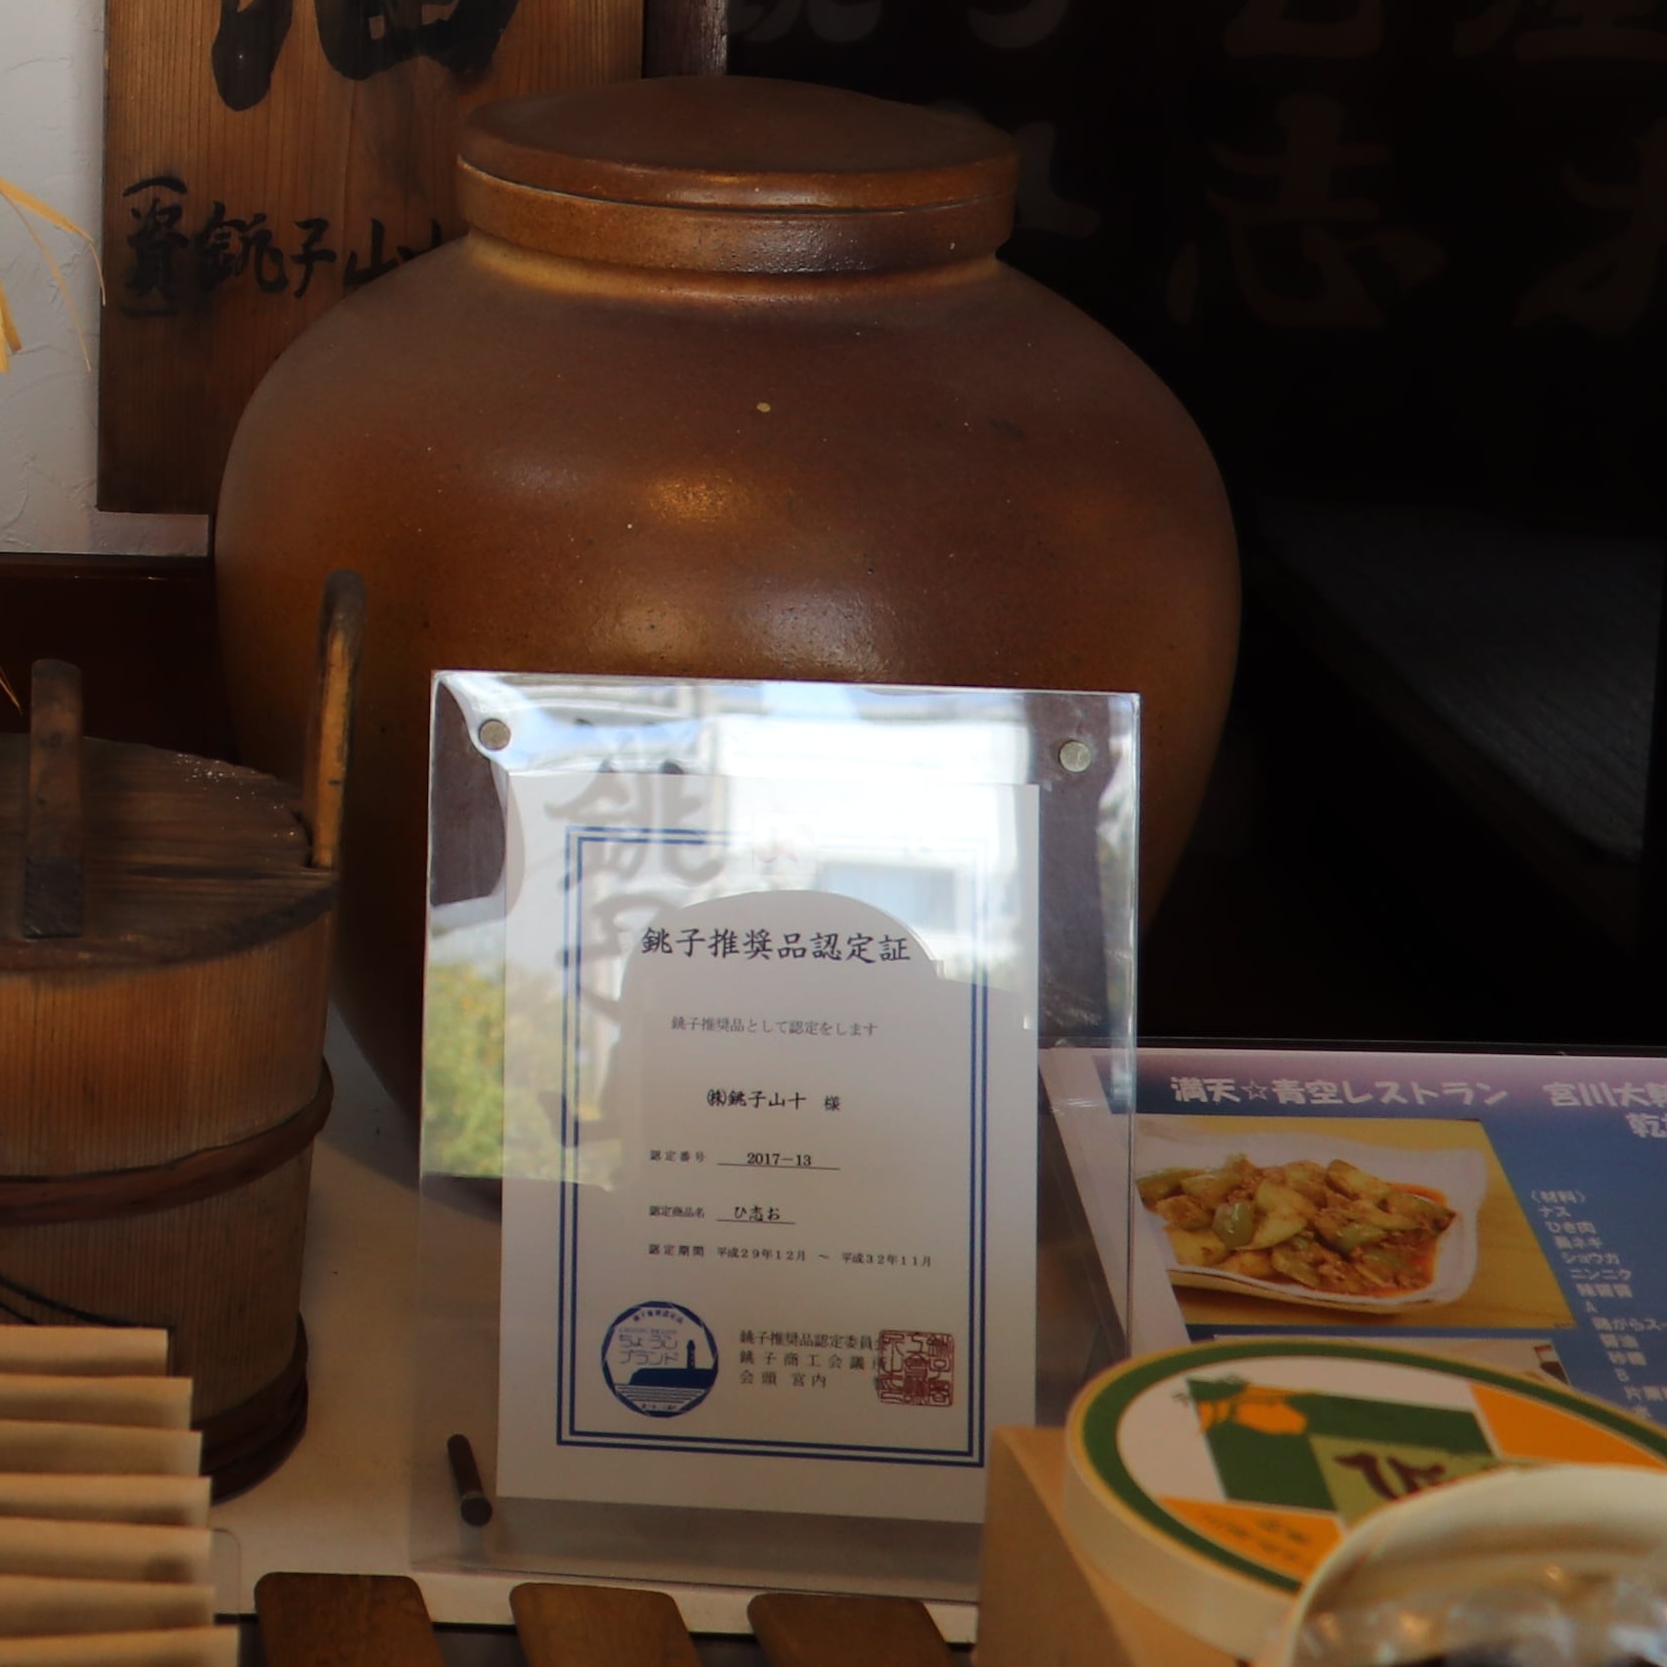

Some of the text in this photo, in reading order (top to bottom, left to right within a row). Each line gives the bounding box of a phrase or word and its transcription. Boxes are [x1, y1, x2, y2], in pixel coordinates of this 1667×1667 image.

[641, 926, 911, 964] 銚子推奨品認定証
